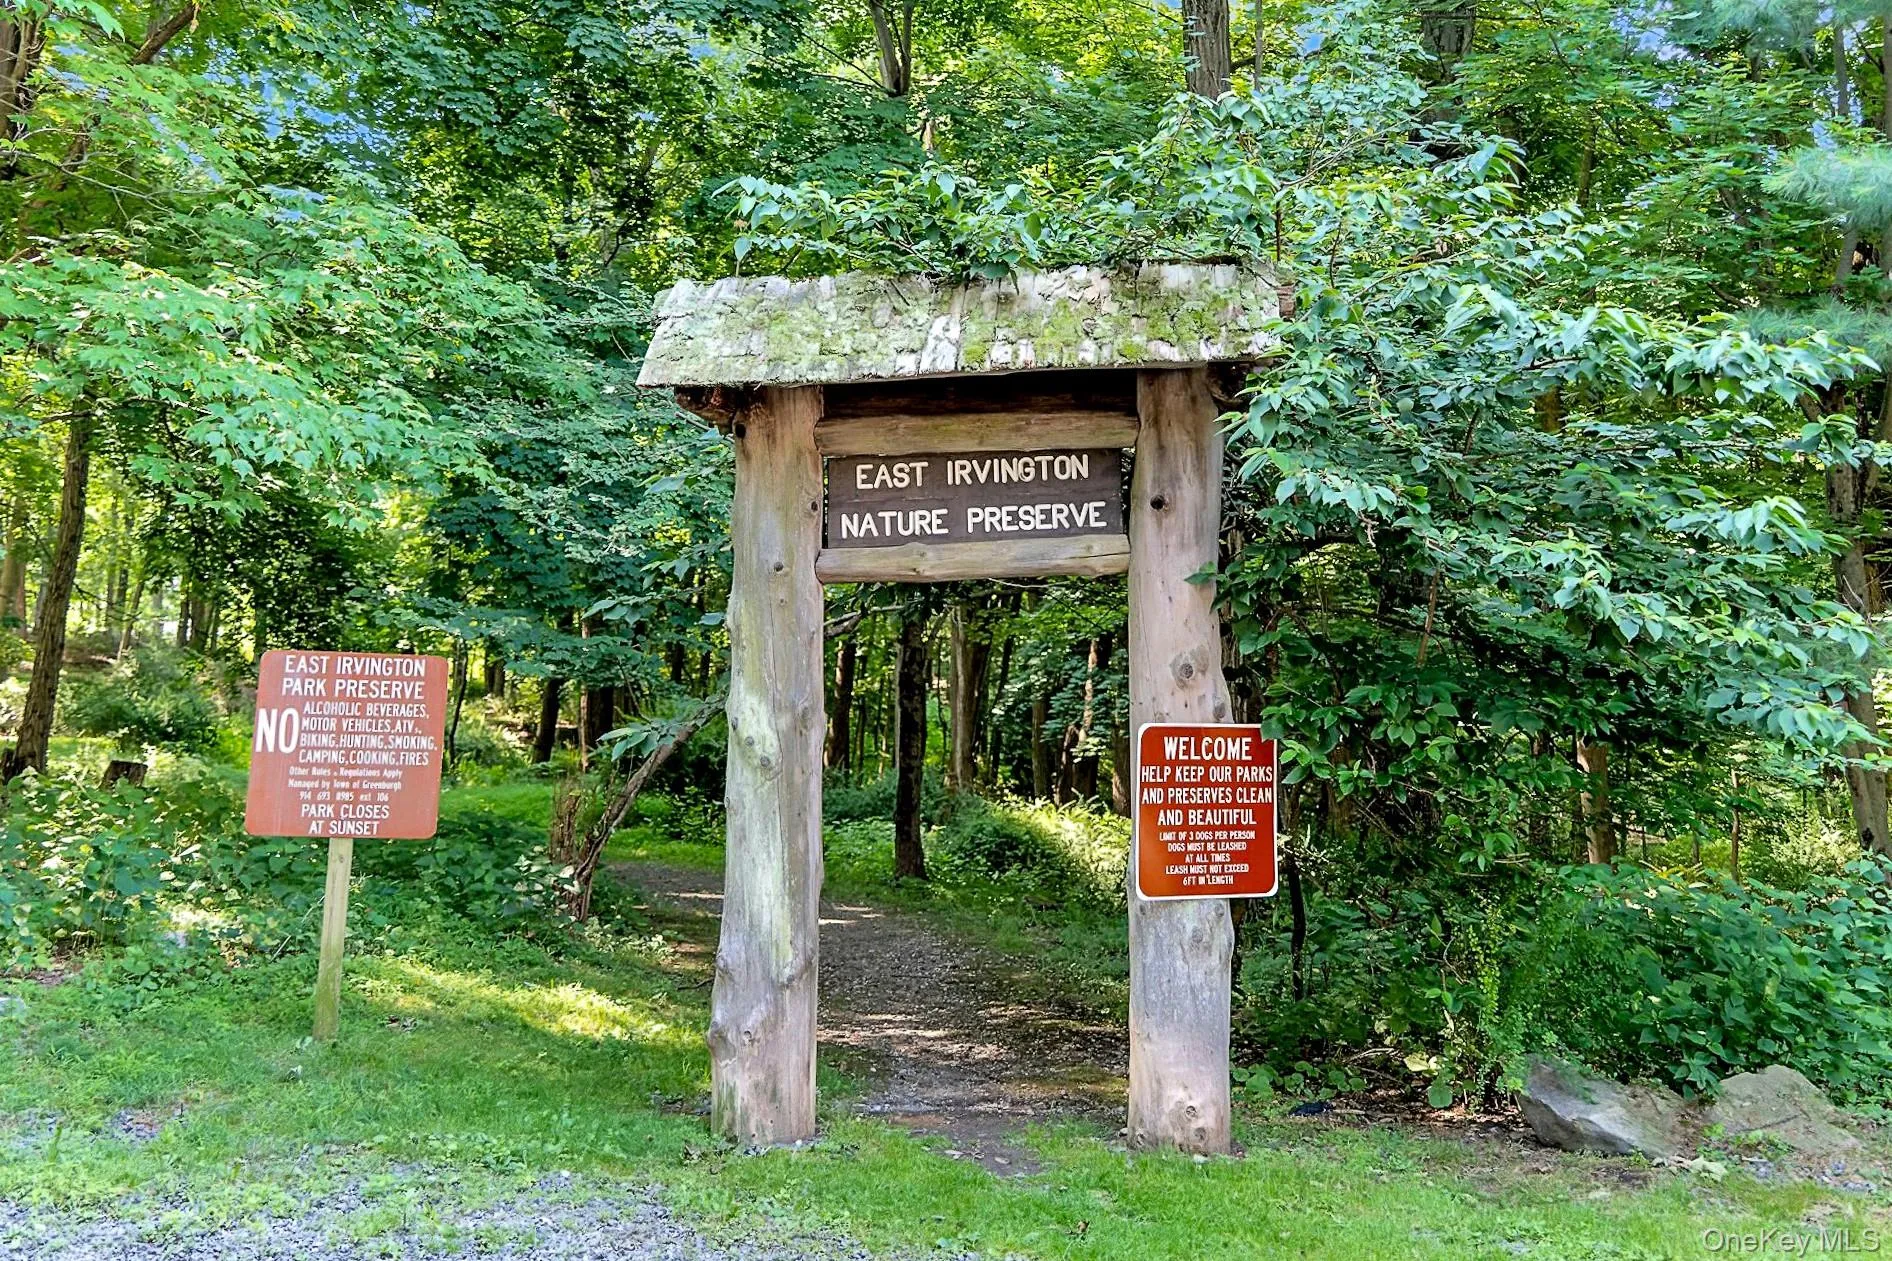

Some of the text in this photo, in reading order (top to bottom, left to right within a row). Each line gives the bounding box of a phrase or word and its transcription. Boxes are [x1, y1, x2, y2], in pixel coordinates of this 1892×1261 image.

[856, 454, 1088, 489] EAST IRVINGTON
[841, 501, 1107, 539] NATURE PRESERVE
[285, 655, 425, 677] EAST IRVINGTON
[282, 678, 424, 699] PARK PRESERVE
[303, 702, 429, 718] ALCOHOLIC BEVERAGES,
[255, 708, 299, 753] NO
[301, 717, 336, 731] MOTOR
[1164, 737, 1252, 760] WELCOME
[289, 767, 309, 776] Other
[312, 767, 331, 776] Rules
[340, 767, 380, 778] Regulations
[383, 769, 402, 778] Apply
[1142, 766, 1272, 782] HELP KEEP OUR PARKS
[288, 779, 401, 791] Managed by Town of Greenburgh
[300, 791, 311, 800] 914
[317, 792, 330, 800] 693
[377, 793, 388, 801] 106
[1142, 787, 1272, 804] AND PRESERVES CLEAN
[301, 804, 389, 819] PARK CLOSES
[1158, 809, 1256, 825] AND BEAUTIFUL
[309, 820, 379, 835] AT SUNSET
[1160, 831, 1255, 840] LIMIT OF 3 DOGS PER PERSON
[1168, 842, 1247, 852] DOGS MUST BE LEASHED
[1185, 854, 1230, 863] AT ALL TIMES
[1166, 864, 1249, 874] LEASH MUST NOT EXCEED
[1183, 875, 1233, 885] 6FT IN LENGTH
